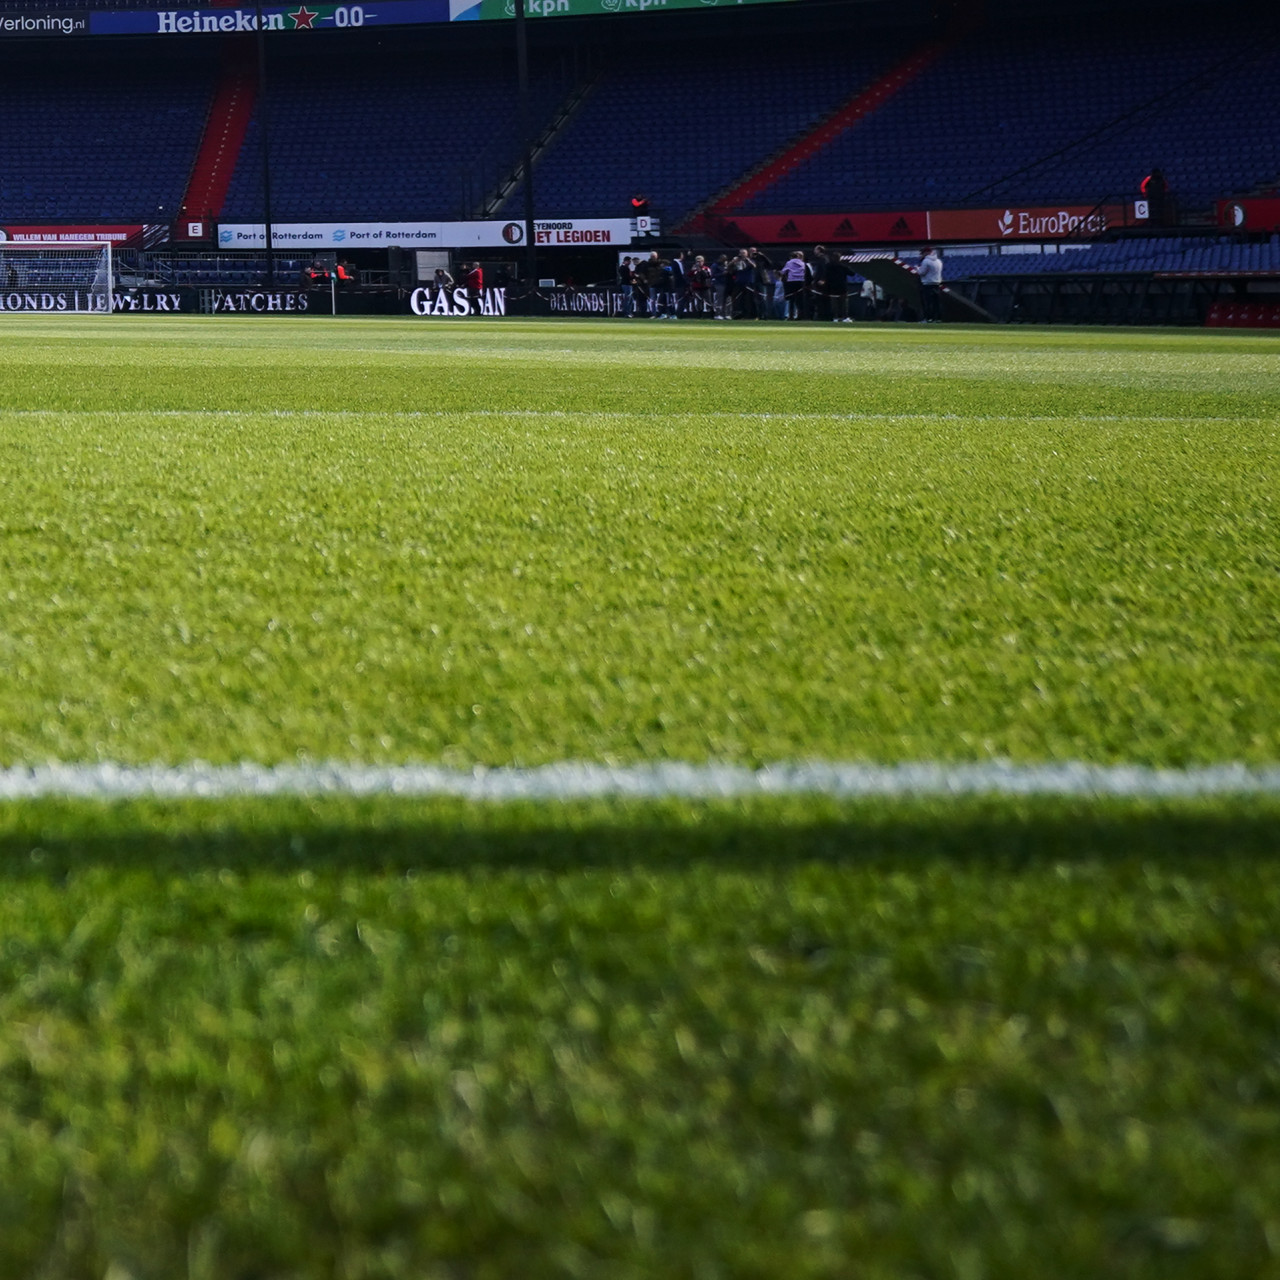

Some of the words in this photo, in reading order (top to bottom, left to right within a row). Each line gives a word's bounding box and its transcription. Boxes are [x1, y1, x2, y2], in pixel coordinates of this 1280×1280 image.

[157, 9, 285, 34] Heineken
[533, 222, 573, 230] EYENOORD
[237, 231, 257, 240] Port
[272, 231, 323, 240] Rotterdam
[349, 230, 368, 239] Port
[371, 230, 383, 239] of
[385, 230, 437, 239] Rotterdam
[557, 230, 611, 243] LEGIOEN
[410, 288, 506, 316] GASAN
